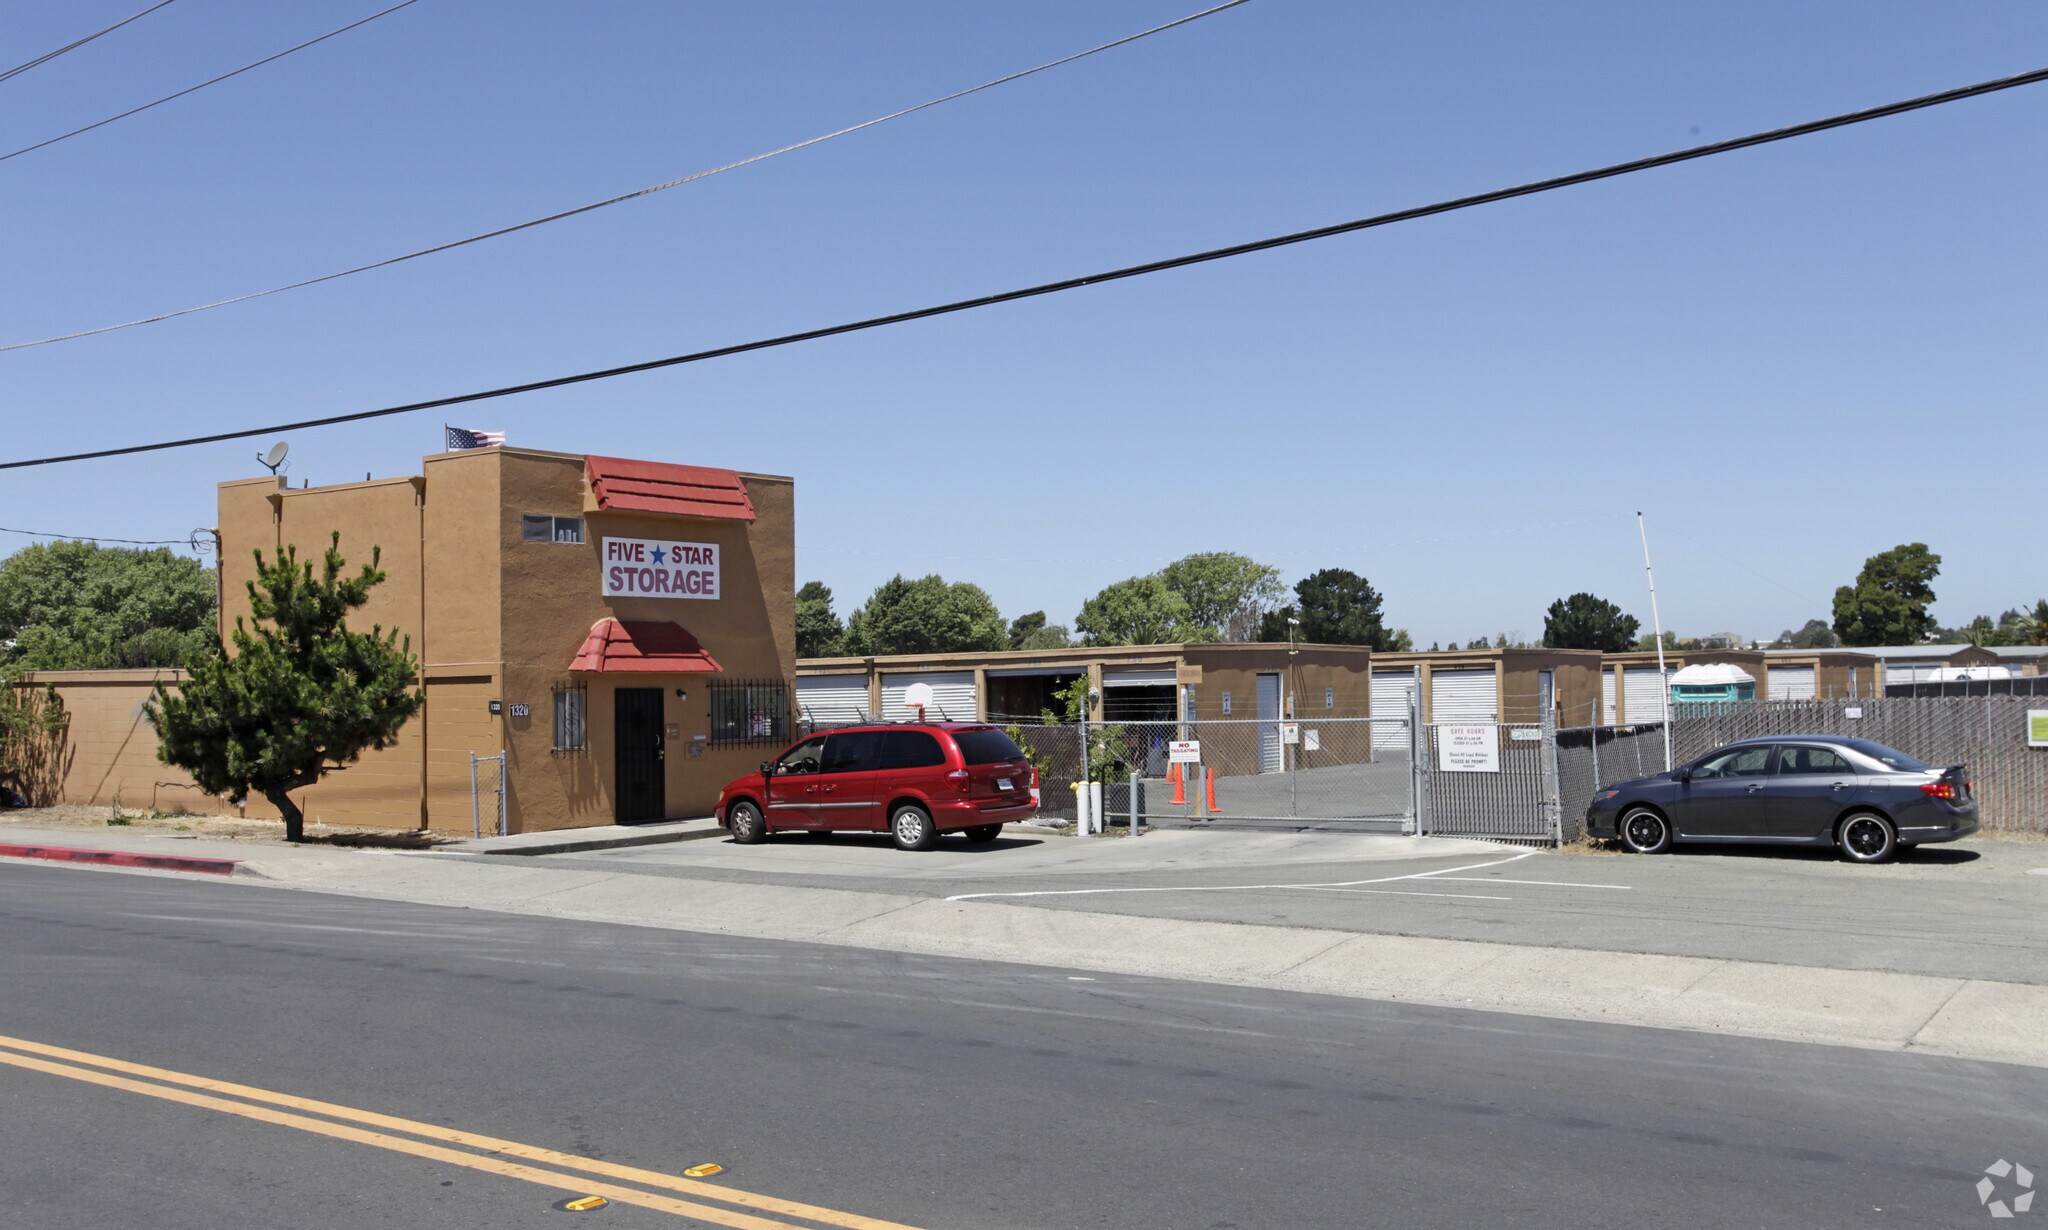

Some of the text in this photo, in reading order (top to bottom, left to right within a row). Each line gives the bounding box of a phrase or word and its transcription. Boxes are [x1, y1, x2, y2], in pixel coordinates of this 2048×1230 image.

[608, 542, 714, 565] FIVE STAR
[608, 566, 715, 595] STORAGE
[490, 703, 501, 711] 1320
[510, 704, 529, 717] 1320
